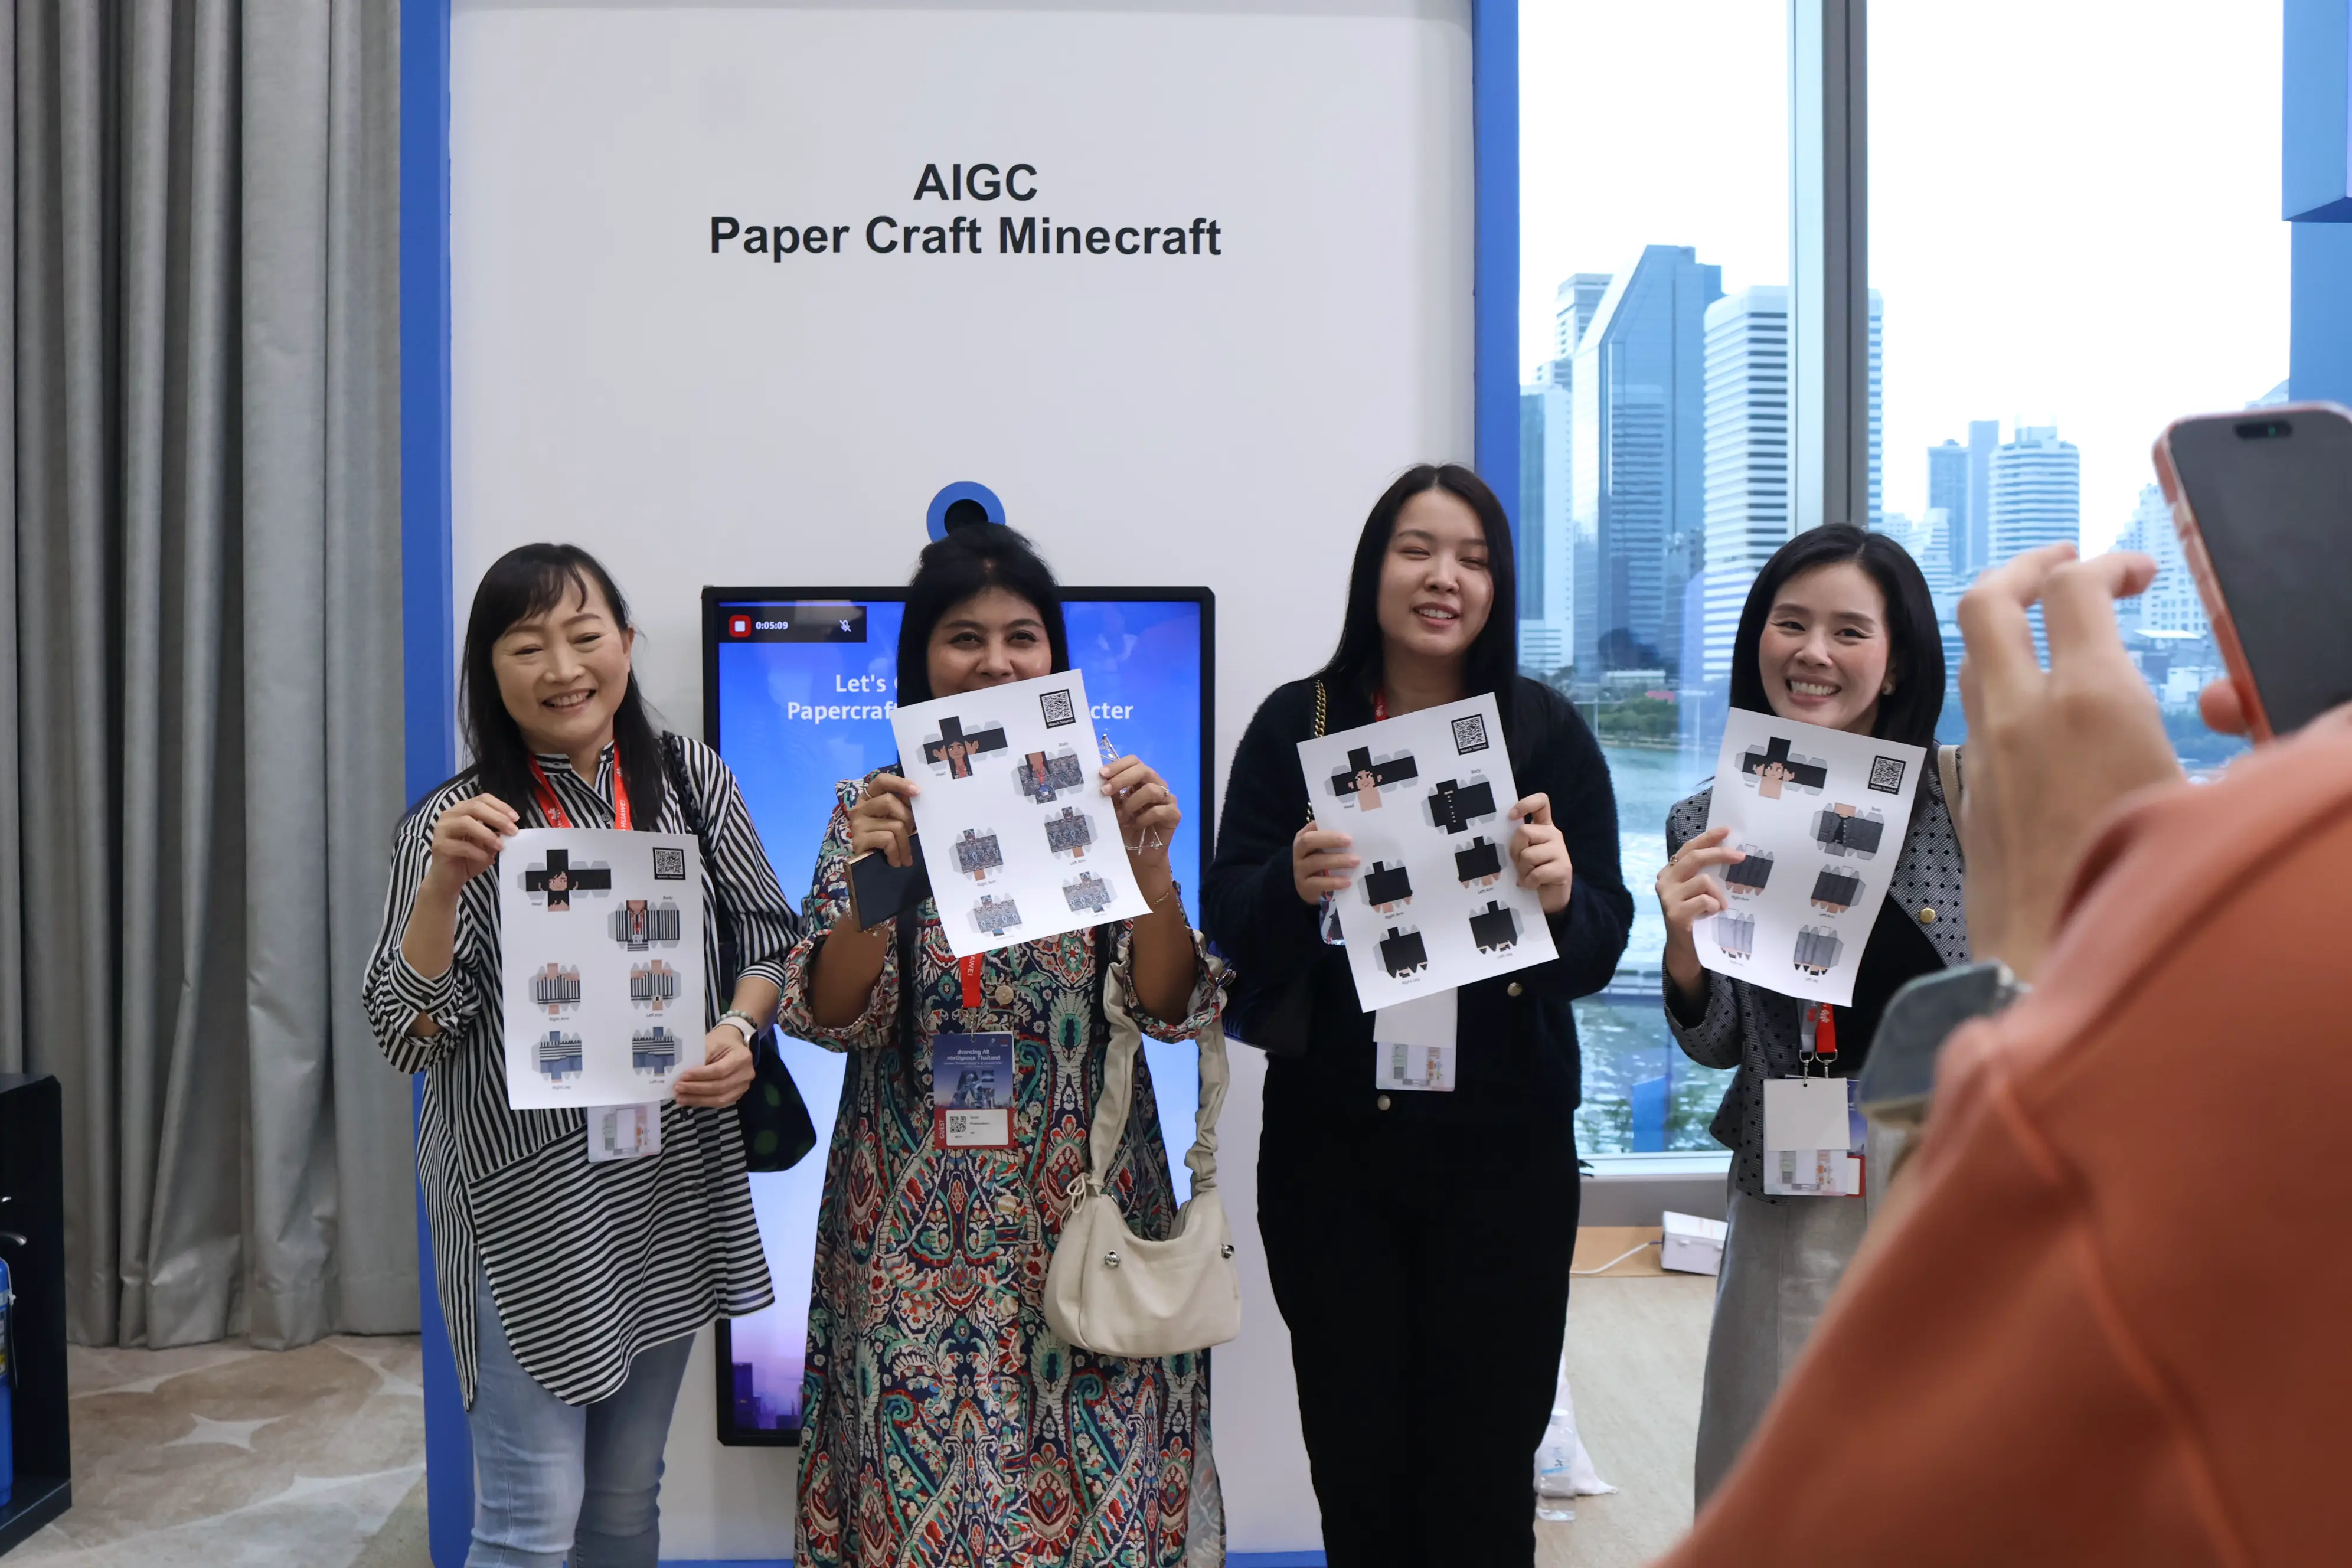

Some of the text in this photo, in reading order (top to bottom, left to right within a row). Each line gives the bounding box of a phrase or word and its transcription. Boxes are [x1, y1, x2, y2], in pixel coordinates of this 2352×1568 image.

[913, 163, 1037, 201] AIGC
[711, 215, 1221, 263] Paper Craft Minecraft
[756, 621, 788, 630] 0:05:09
[835, 674, 887, 692] Let's
[1090, 702, 1134, 719] cter
